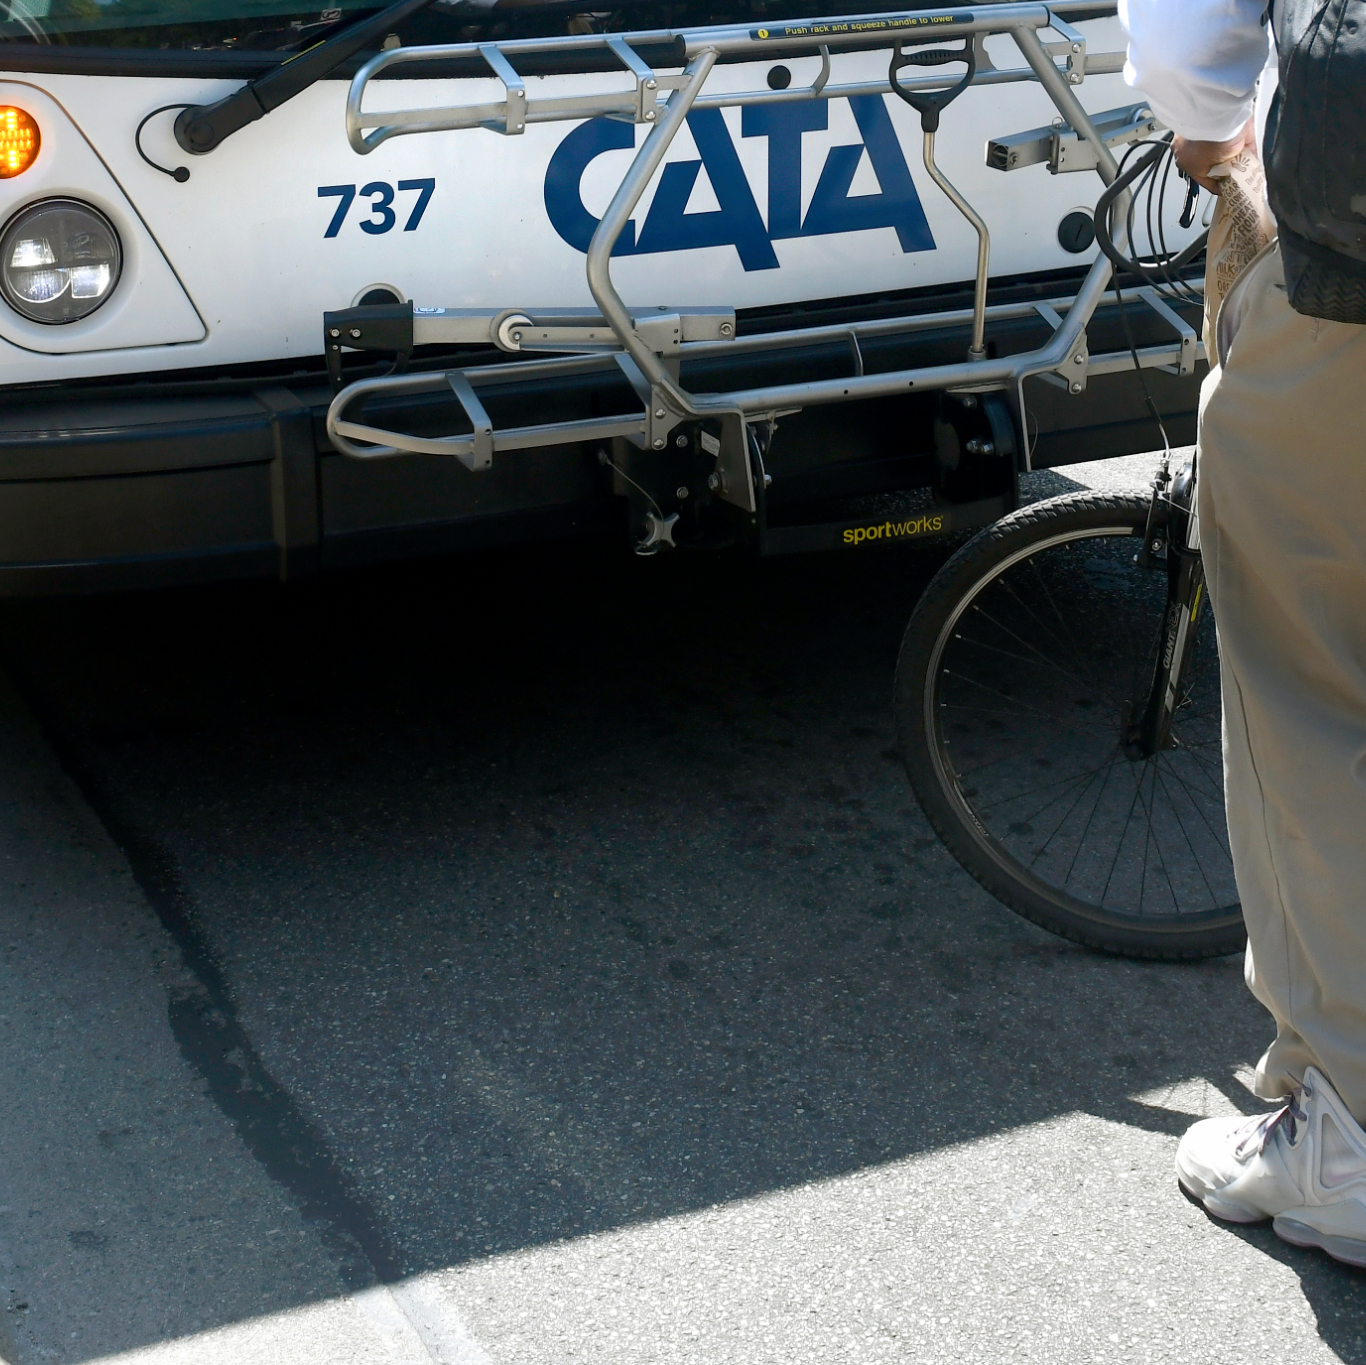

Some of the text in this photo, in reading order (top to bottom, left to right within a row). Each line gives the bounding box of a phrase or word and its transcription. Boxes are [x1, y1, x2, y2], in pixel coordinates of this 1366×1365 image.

[785, 26, 808, 36] Push
[810, 23, 829, 34] rack
[832, 22, 848, 32] and
[851, 20, 886, 31] squeeze
[888, 17, 917, 28] handle
[919, 16, 928, 25] to
[930, 14, 954, 24] lower
[544, 92, 937, 272] CATA
[317, 178, 436, 239] 737
[1236, 209, 1261, 237] FLOUR
[843, 515, 943, 545] sportworks
[1163, 631, 1175, 669] GIANT
